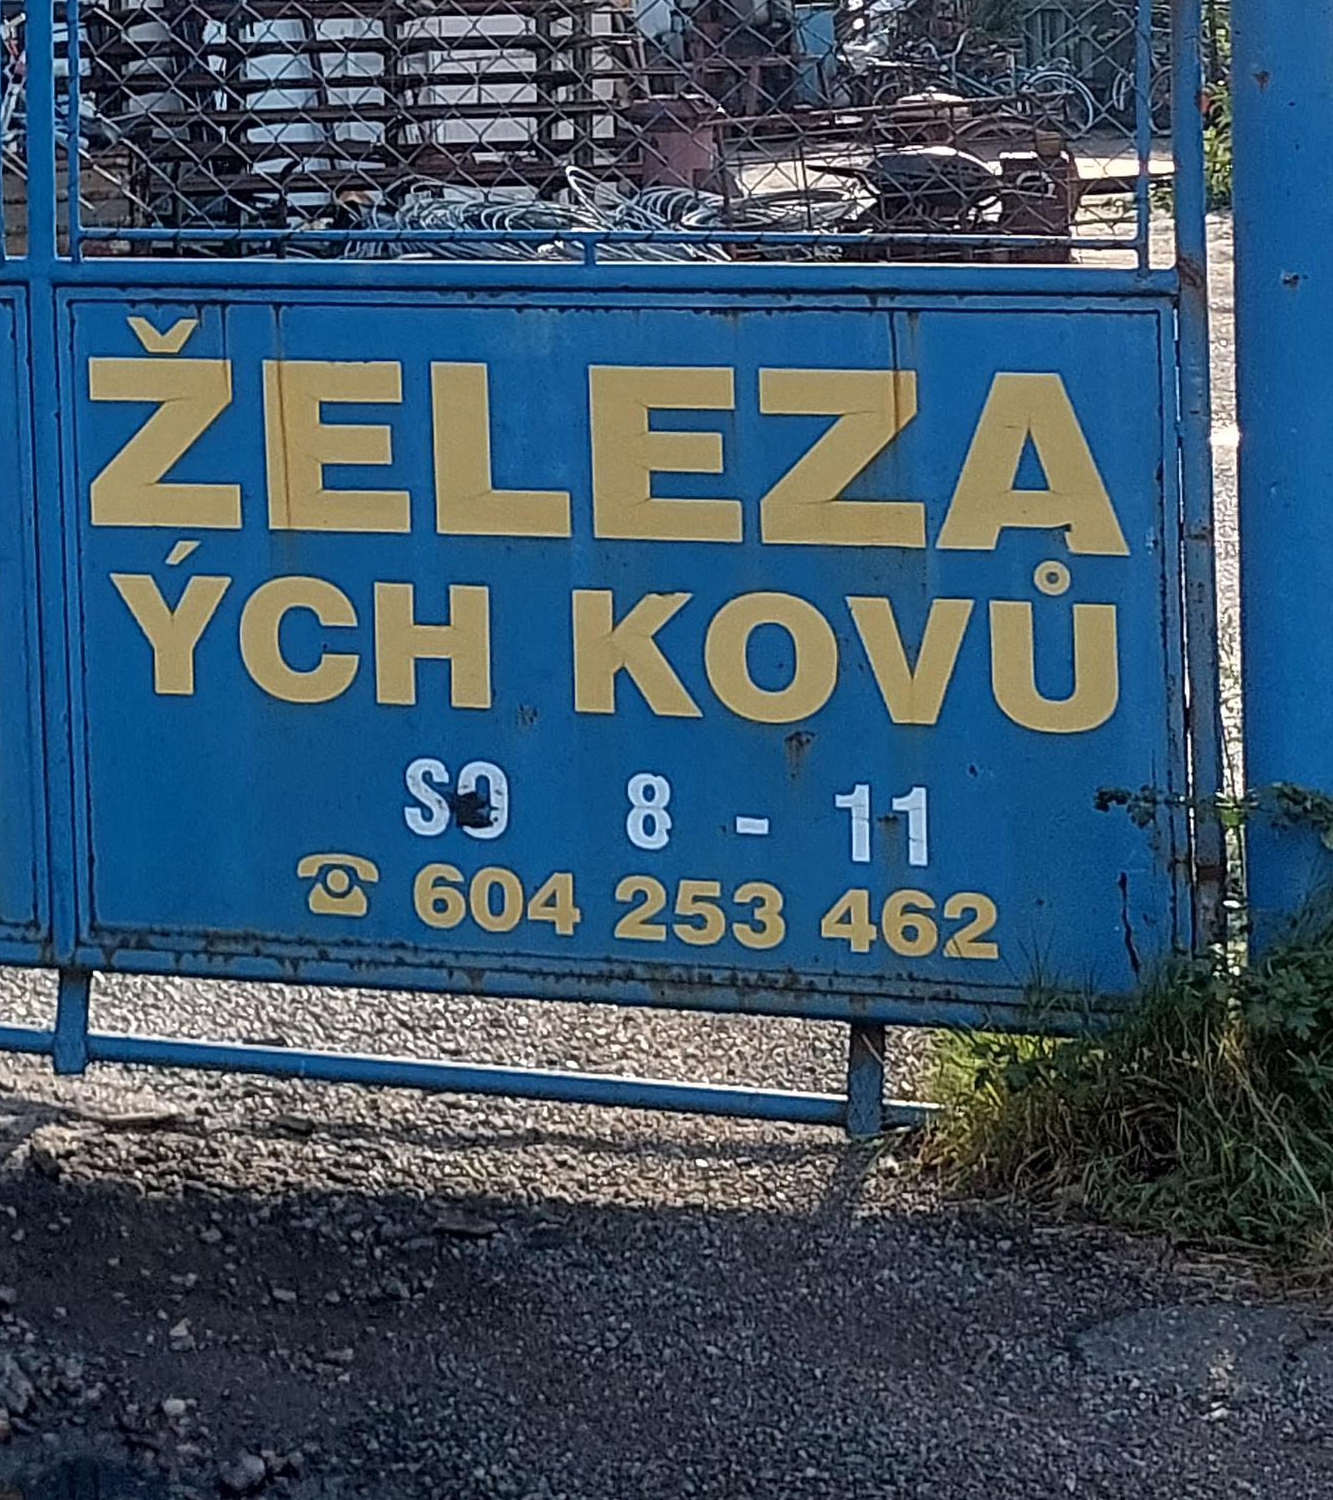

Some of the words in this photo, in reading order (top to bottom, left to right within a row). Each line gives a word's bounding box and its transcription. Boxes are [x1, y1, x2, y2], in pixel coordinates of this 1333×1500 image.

[87, 317, 1131, 557] ŽELEZA
[109, 540, 492, 710] ÝCH
[572, 560, 1120, 734] KOVŮ
[404, 758, 508, 839] SO
[627, 772, 672, 850] 8
[834, 783, 928, 866] 11
[414, 864, 579, 936] 604
[614, 874, 786, 950] 253
[821, 890, 998, 960] 462
